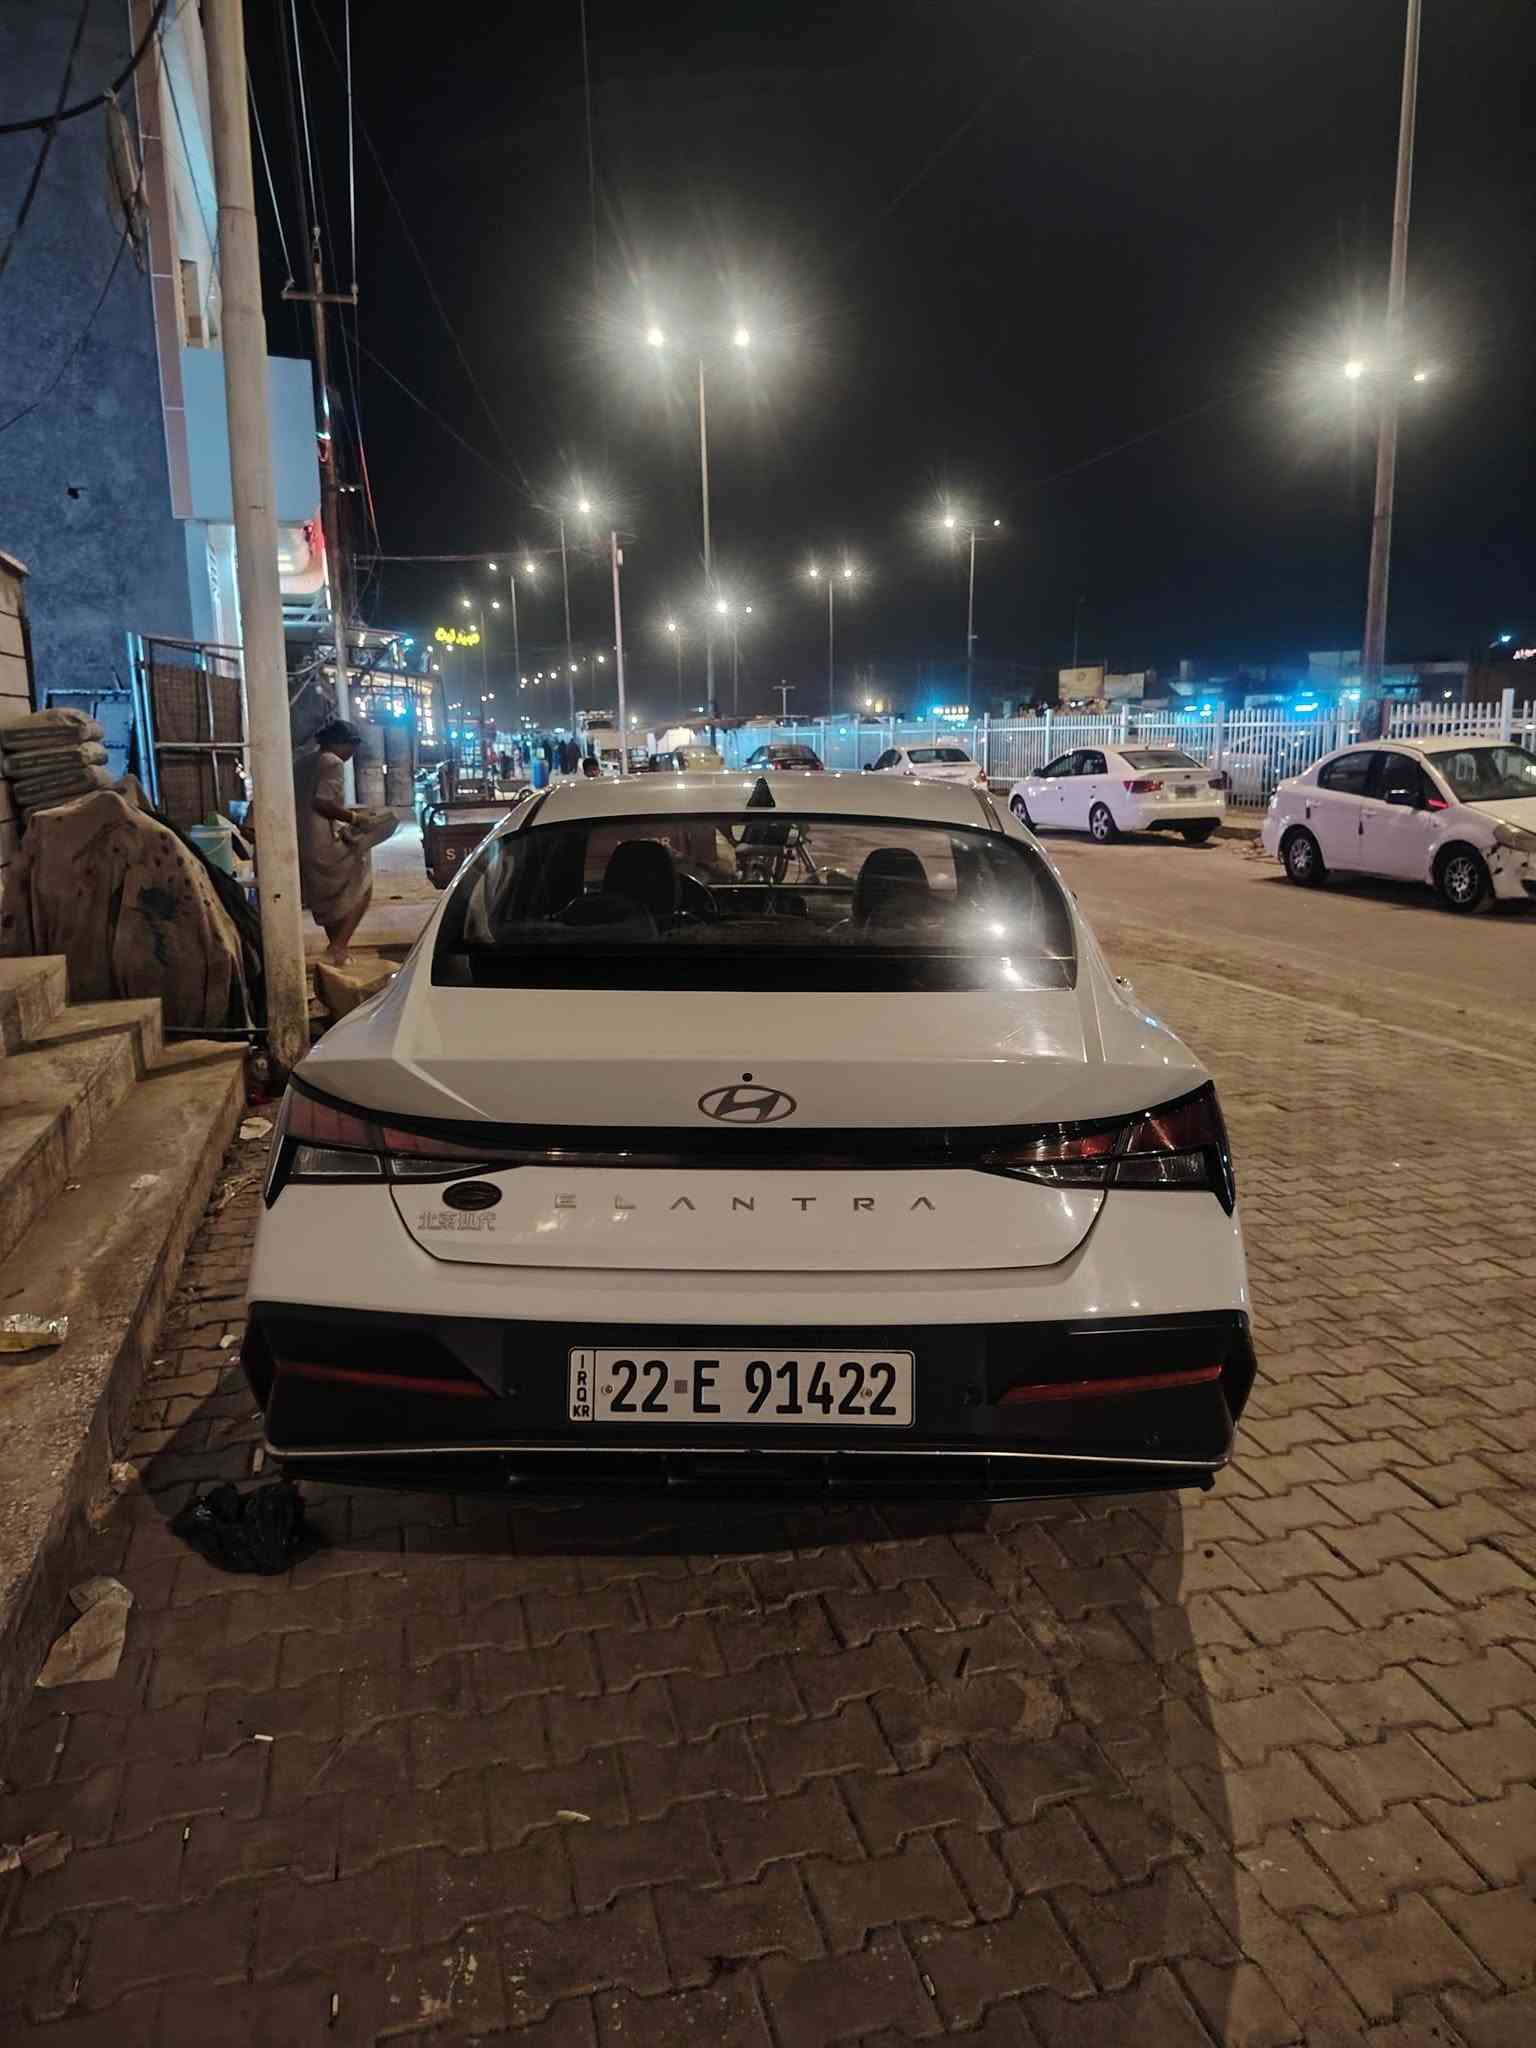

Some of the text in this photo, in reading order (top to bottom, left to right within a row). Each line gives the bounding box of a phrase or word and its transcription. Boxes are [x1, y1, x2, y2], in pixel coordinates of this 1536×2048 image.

[554, 1195, 937, 1212] ELANTRA
[576, 1354, 587, 1402] IRQ
[610, 1360, 897, 1416] 22 E 91422
[573, 1405, 590, 1417] KR
